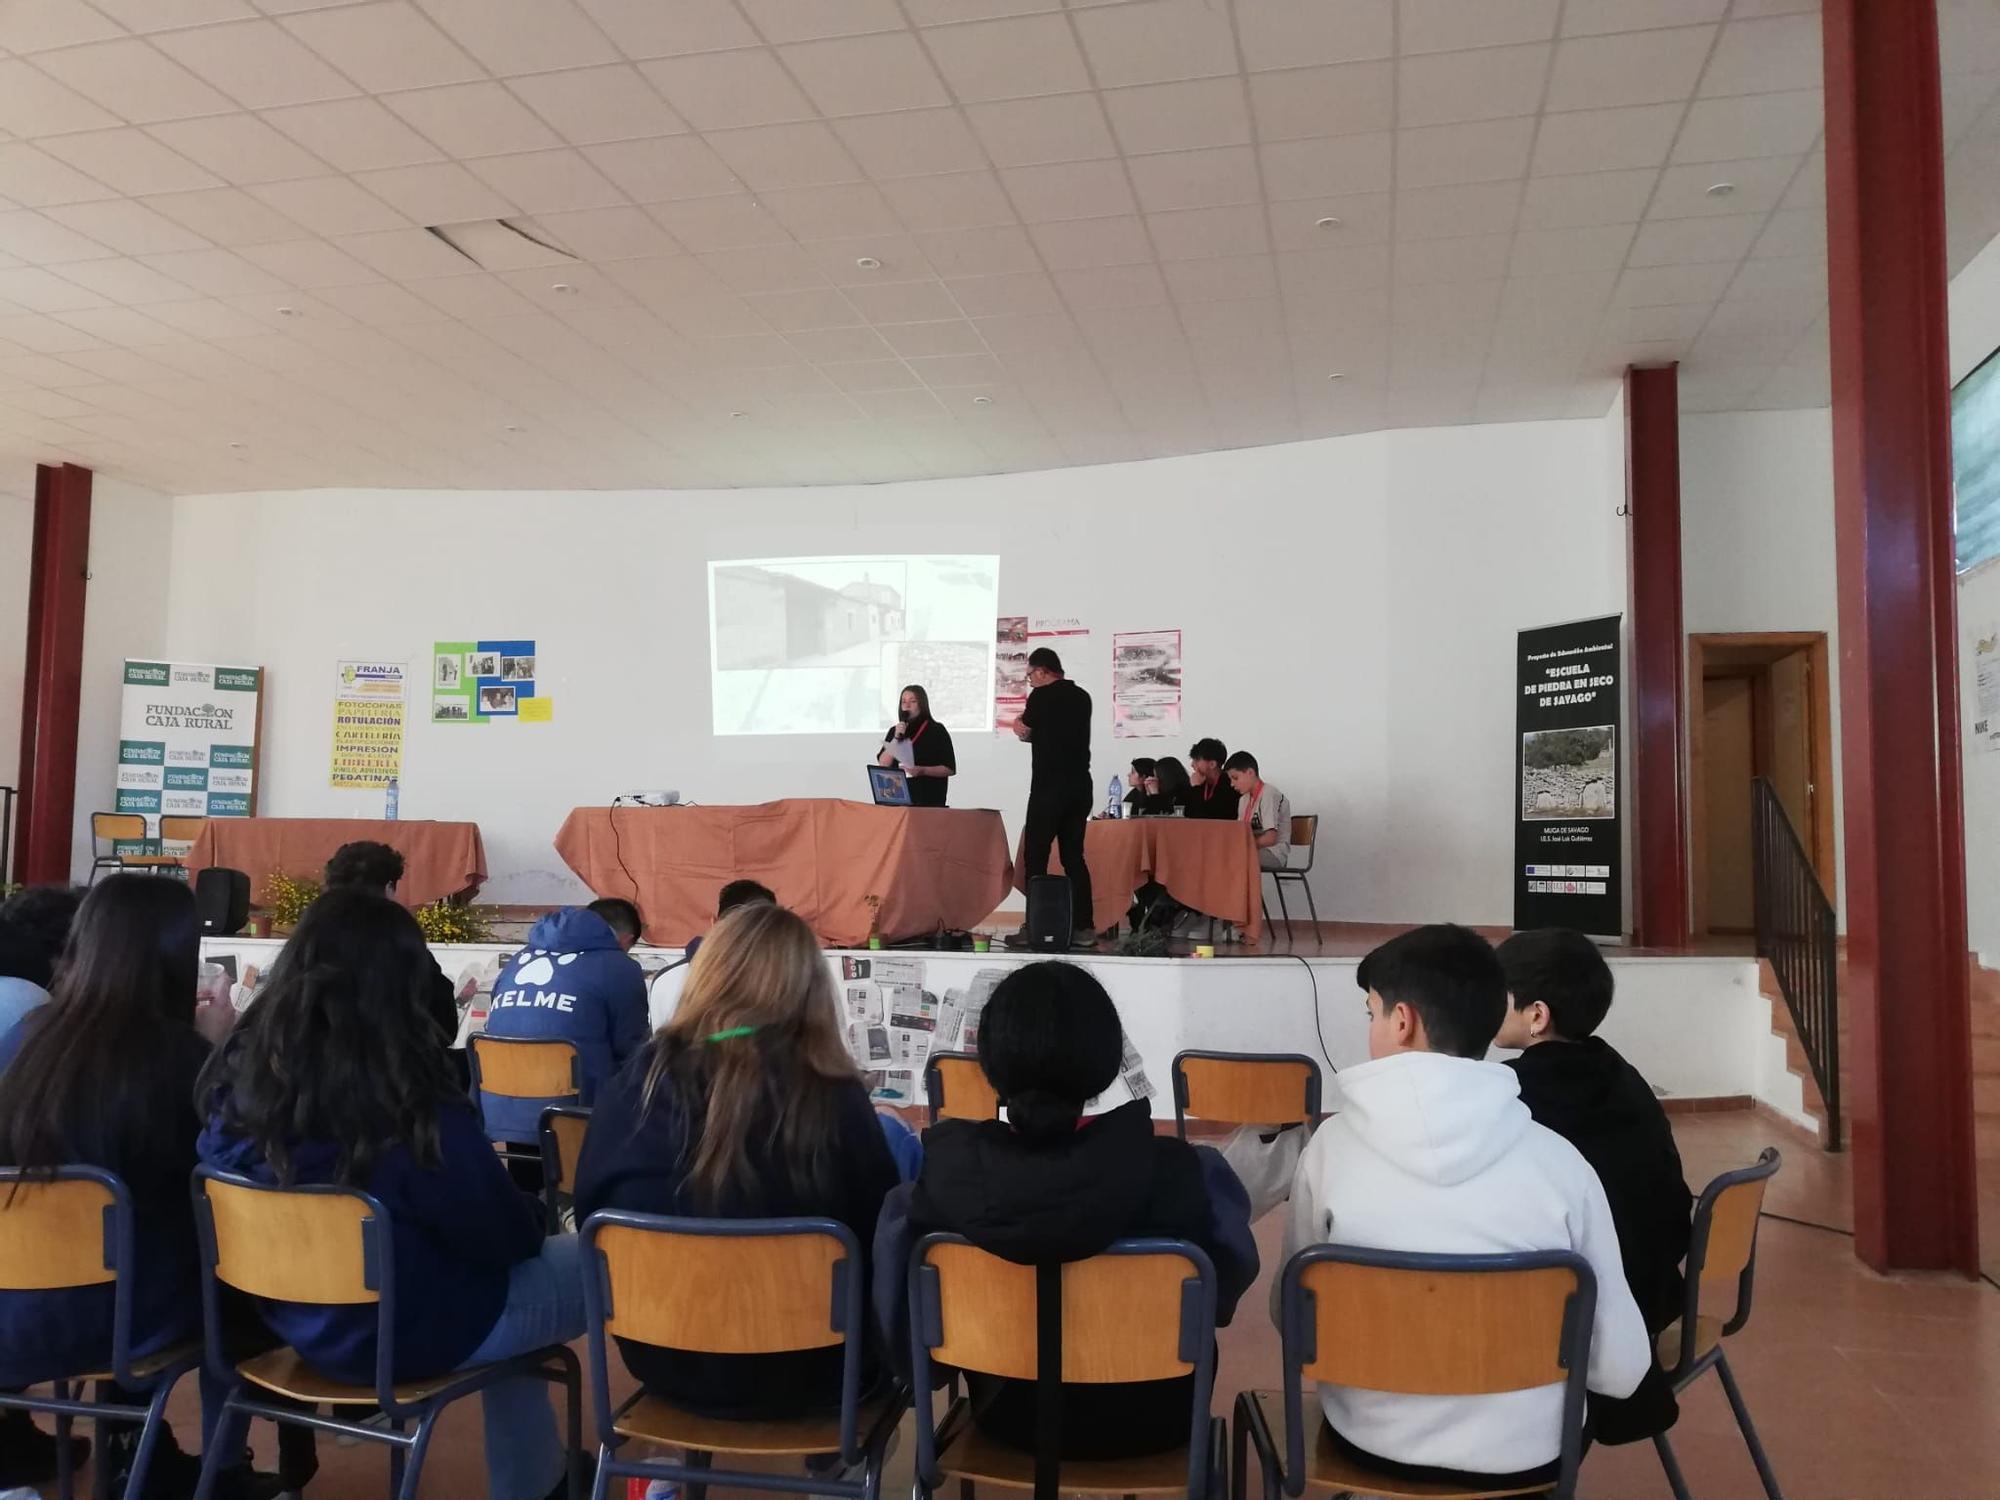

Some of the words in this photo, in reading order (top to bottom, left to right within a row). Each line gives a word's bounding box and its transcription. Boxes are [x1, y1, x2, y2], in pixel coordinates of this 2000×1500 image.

[1524, 684, 1537, 695] DE
[1538, 680, 1572, 693] PIEDRA
[1574, 678, 1587, 689] EN
[1589, 675, 1614, 688] SECO
[1540, 697, 1552, 707] DE
[145, 715, 180, 728] CAJA
[184, 717, 233, 730] RURAL
[490, 989, 577, 1013] KELME
